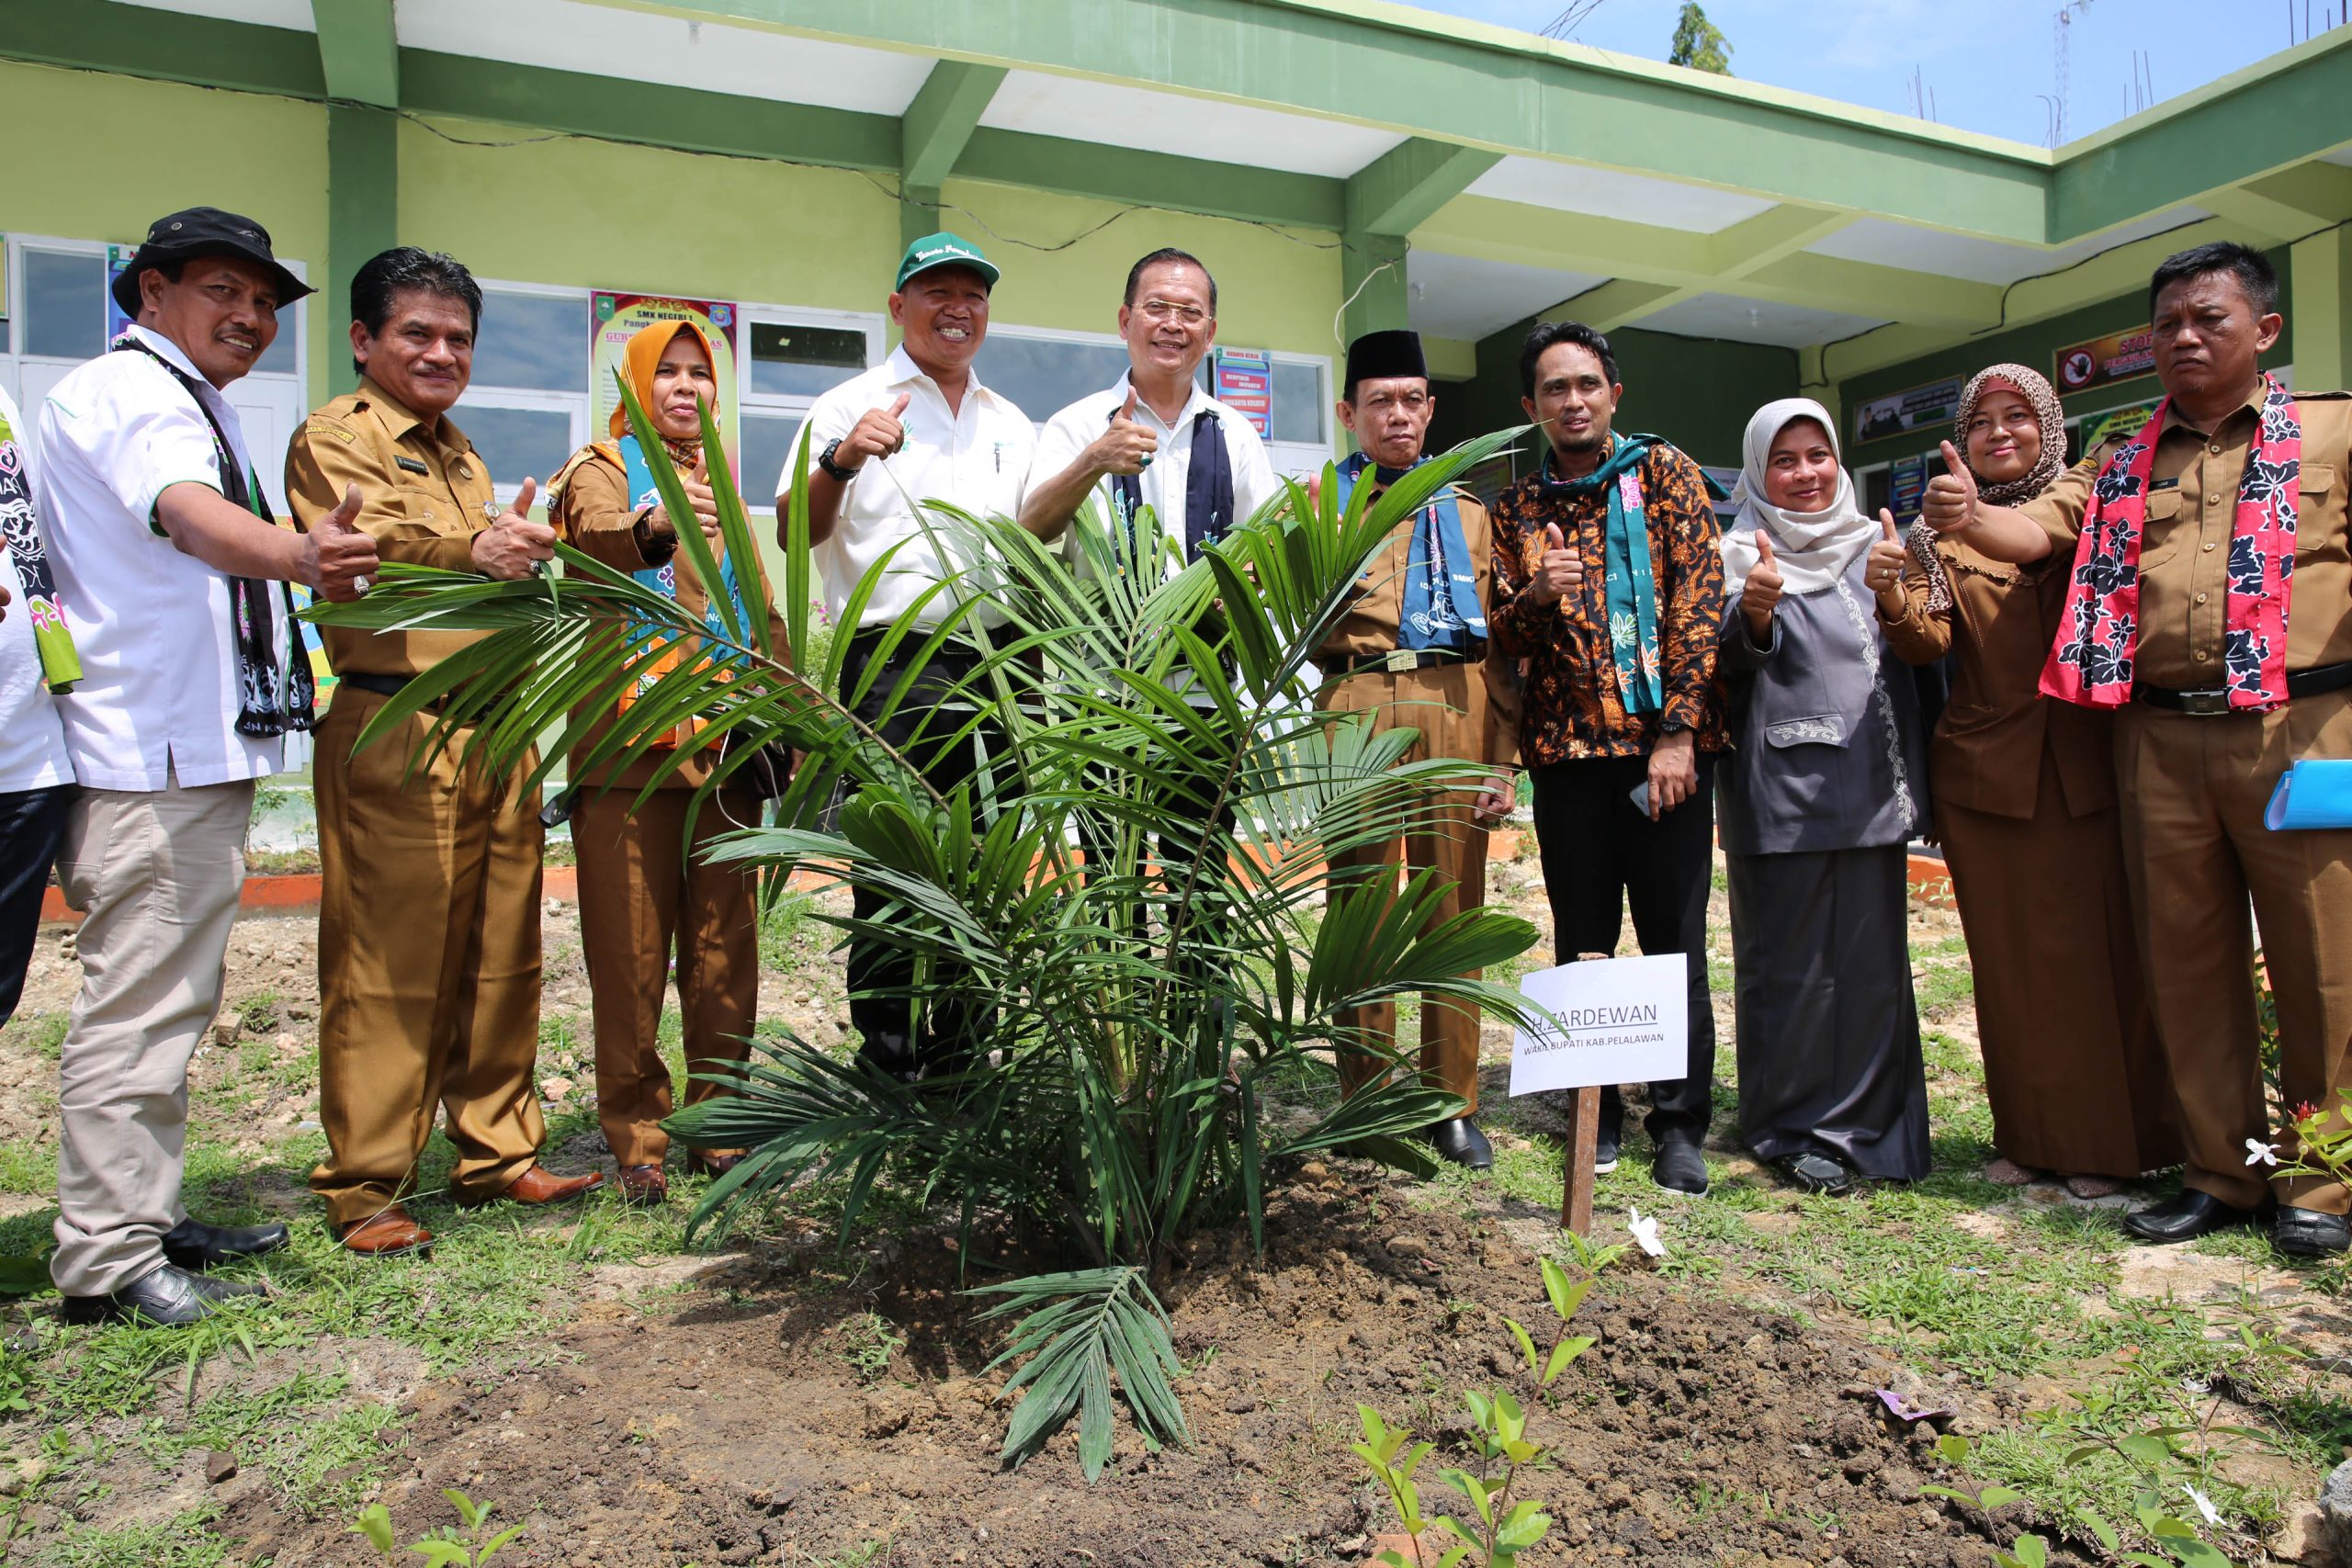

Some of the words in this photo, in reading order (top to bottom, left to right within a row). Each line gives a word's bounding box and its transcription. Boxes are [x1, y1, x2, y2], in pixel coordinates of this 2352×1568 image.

[637, 310, 656, 320] SMK
[1532, 1004, 1657, 1032] H.ZARDEWAN
[1550, 1037, 1584, 1051] BUPATI
[1586, 1033, 1664, 1048] KAB.PELALAWAN
